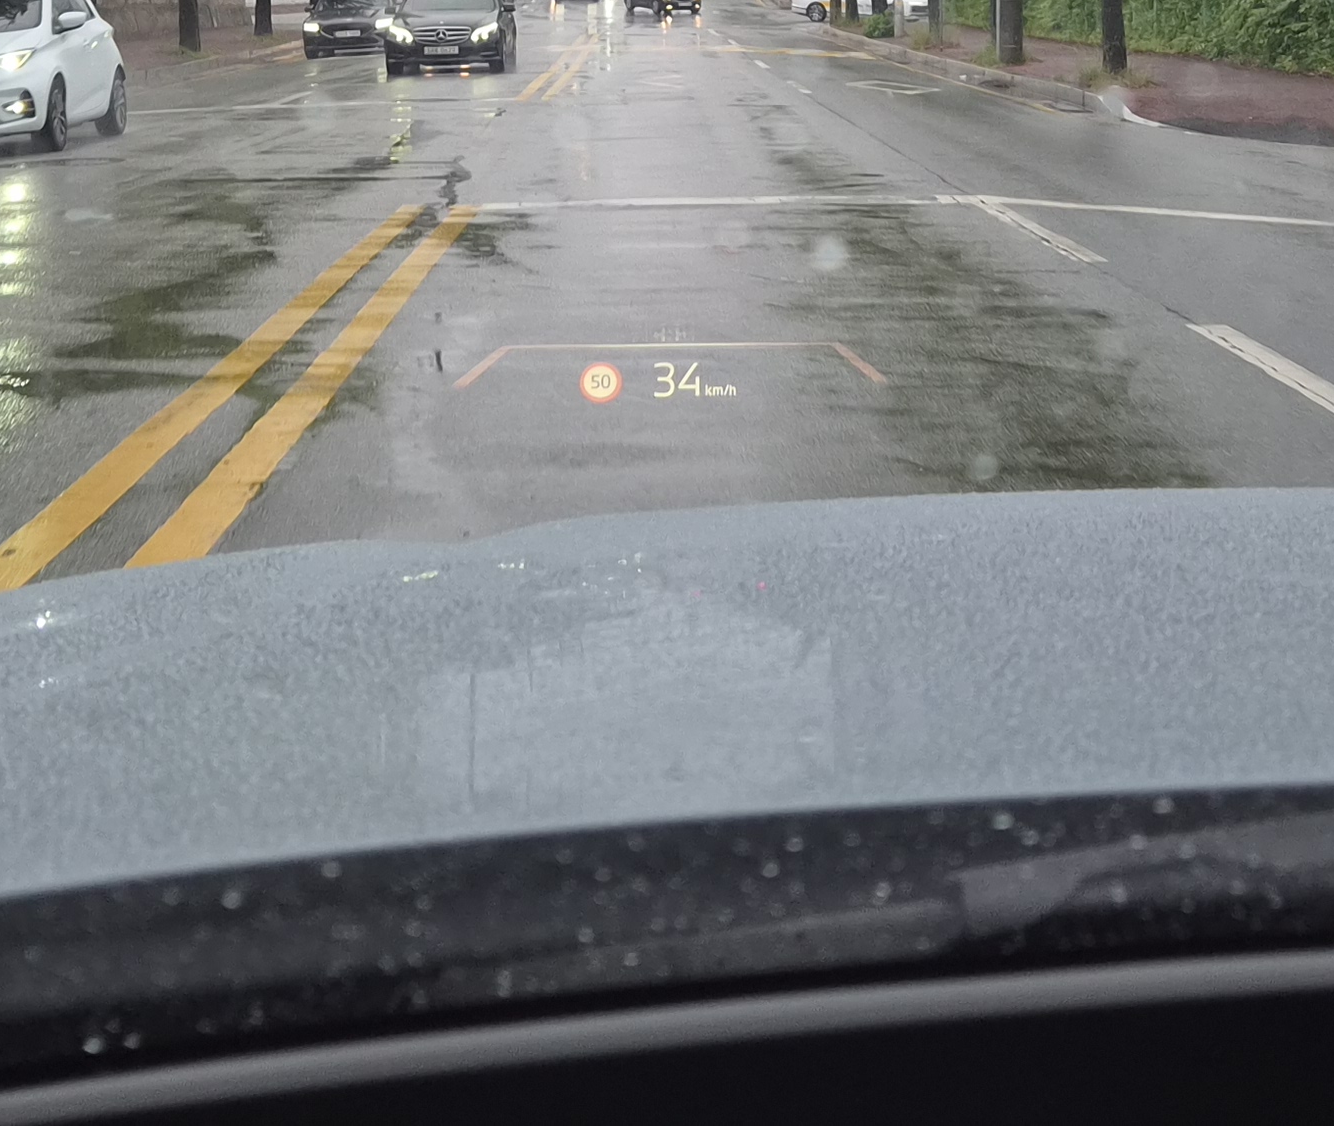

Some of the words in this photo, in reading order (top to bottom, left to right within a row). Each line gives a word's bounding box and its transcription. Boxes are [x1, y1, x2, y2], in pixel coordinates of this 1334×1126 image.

[590, 374, 611, 389] 50
[653, 361, 701, 398] 34
[704, 384, 737, 397] km/h
